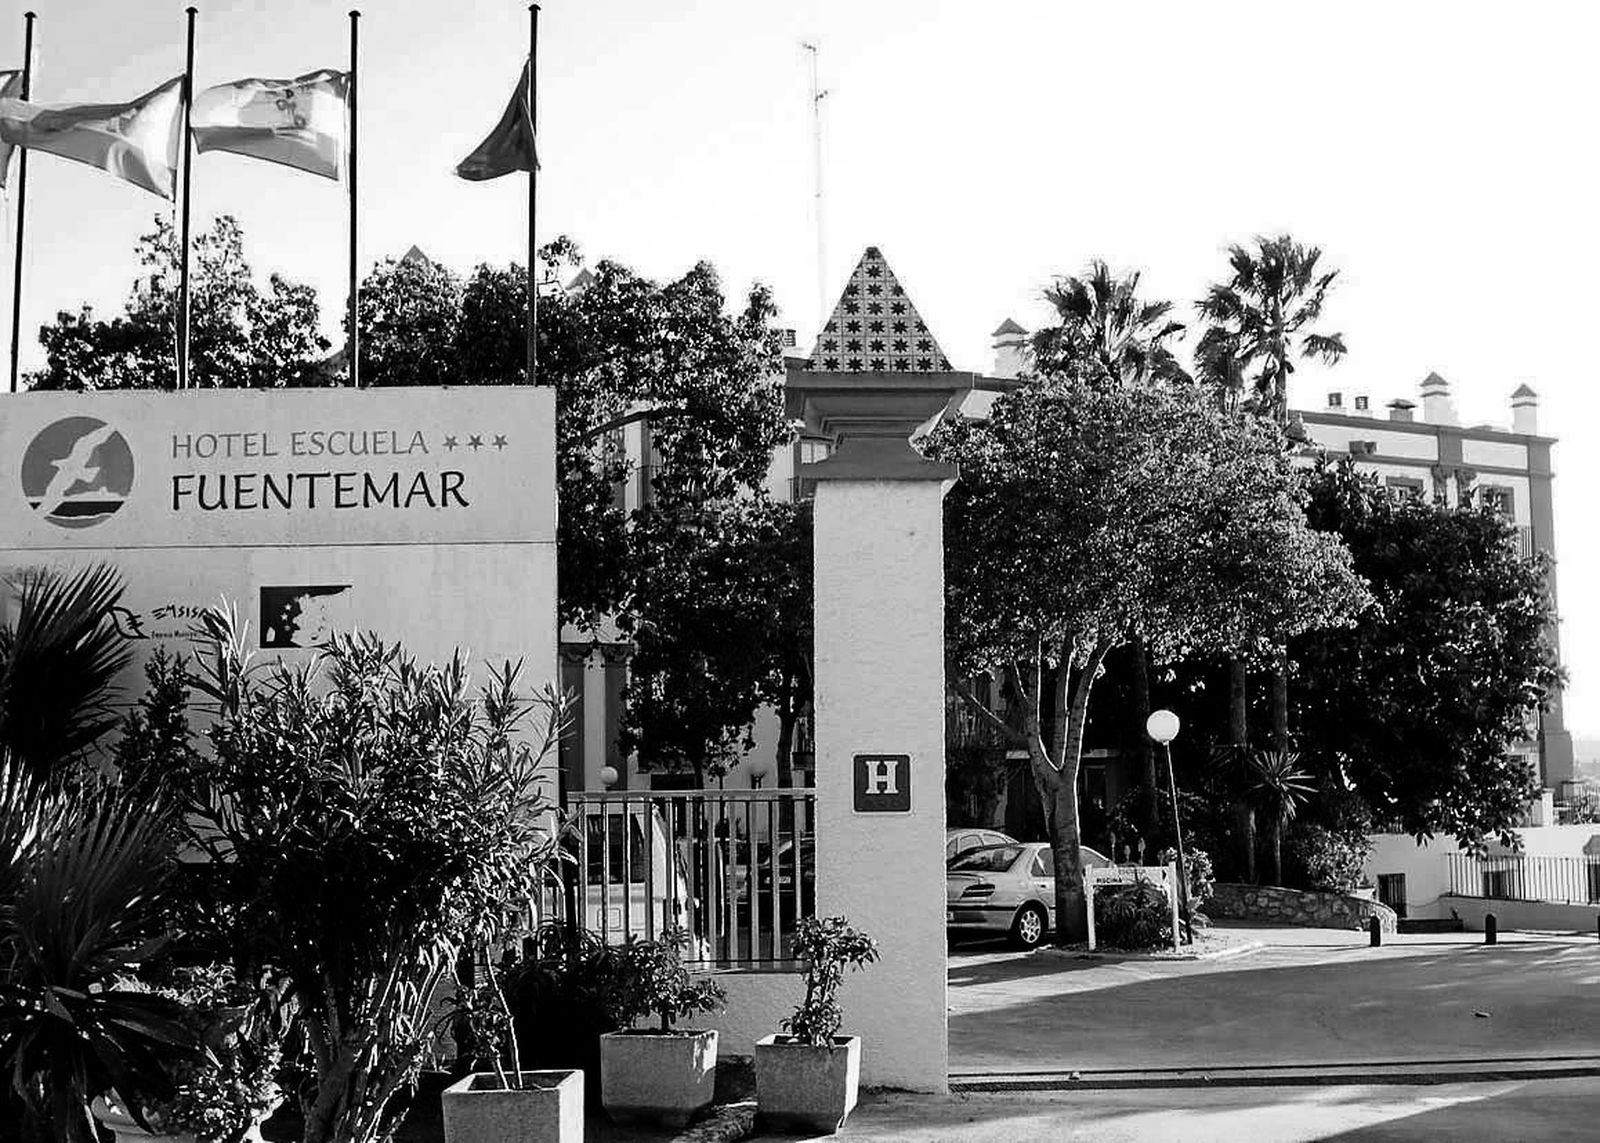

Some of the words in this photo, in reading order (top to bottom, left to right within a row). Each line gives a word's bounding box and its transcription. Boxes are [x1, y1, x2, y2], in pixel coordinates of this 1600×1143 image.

[172, 433, 278, 459] HOTEL
[290, 430, 430, 456] ESCUELA
[172, 471, 470, 511] FUENTEMAR
[865, 760, 899, 794] H
